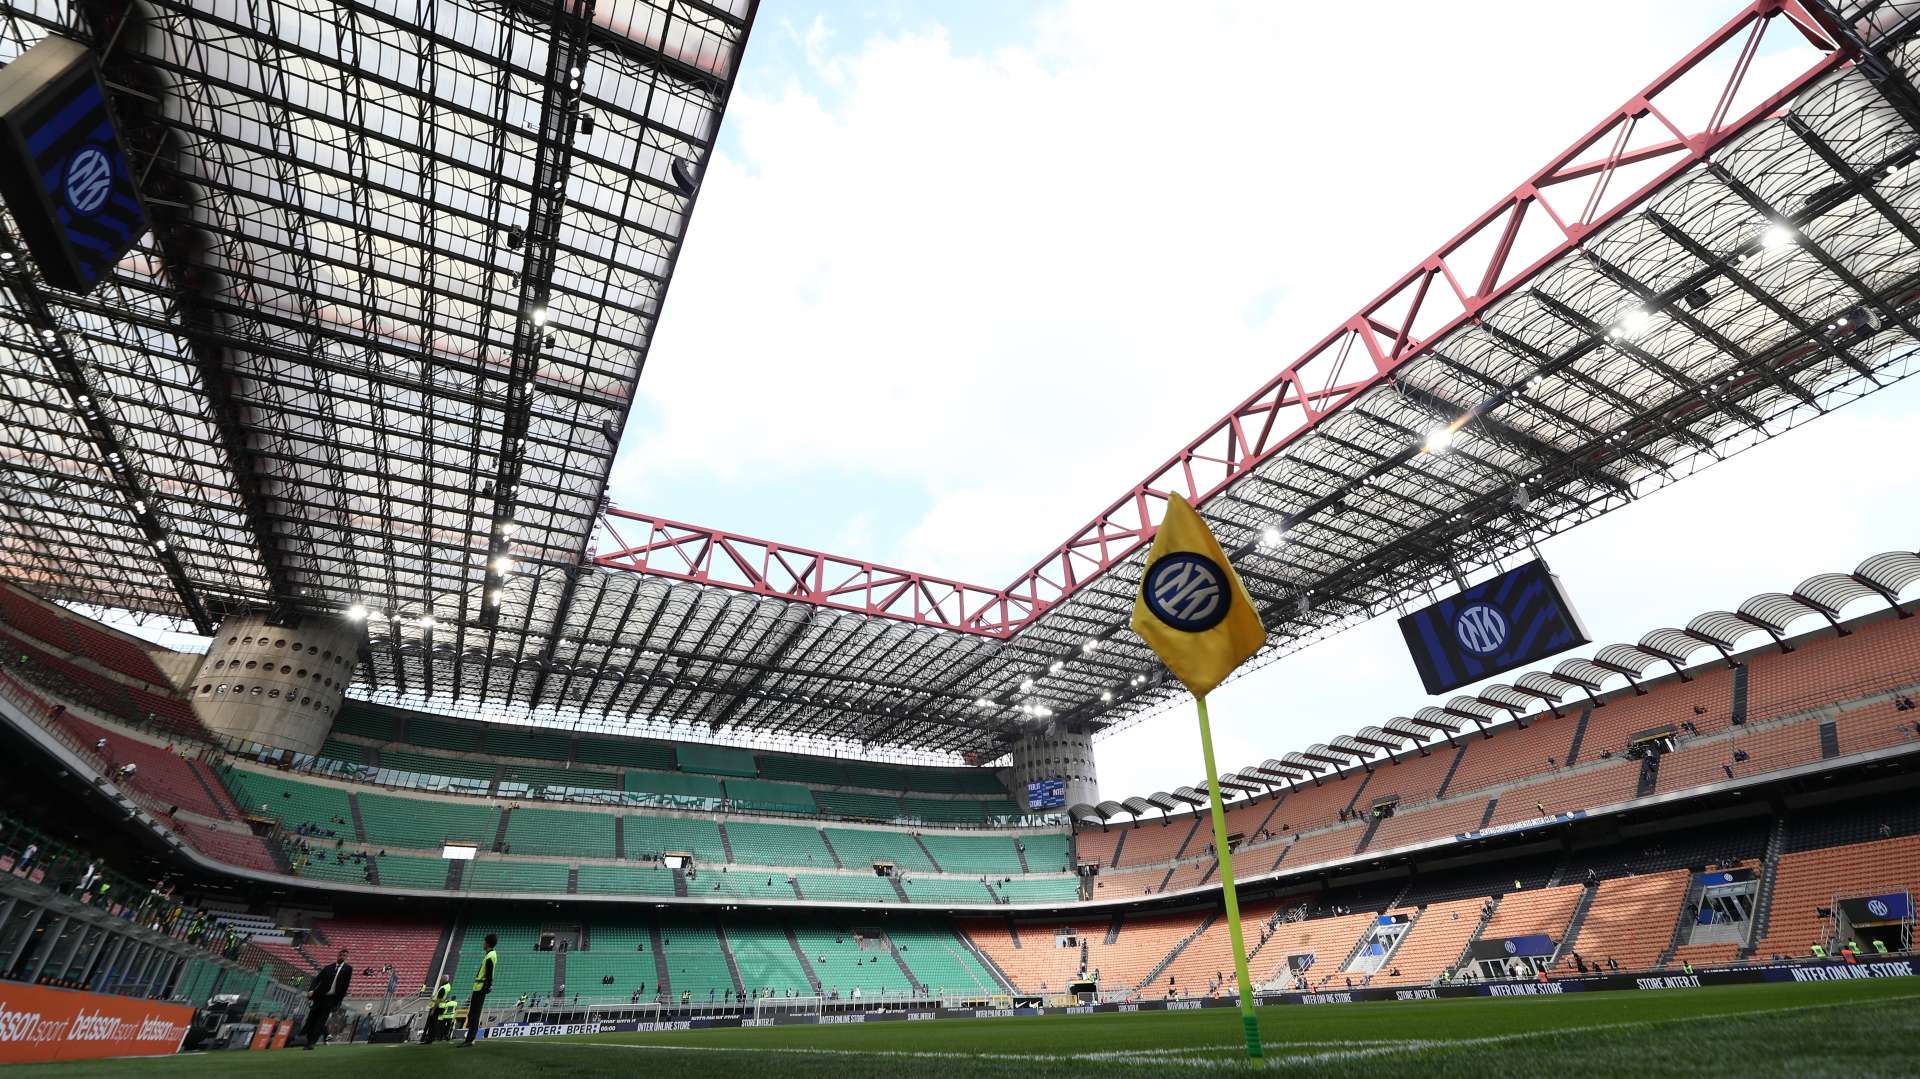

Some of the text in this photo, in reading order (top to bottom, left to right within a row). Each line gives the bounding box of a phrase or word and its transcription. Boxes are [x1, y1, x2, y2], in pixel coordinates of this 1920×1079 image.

[1790, 967, 1828, 982] INTER
[1826, 964, 1870, 980] ONLINE
[1869, 961, 1913, 978] STORE
[1489, 982, 1563, 997] INTER ONLINE STORE
[1637, 976, 1701, 990] STORE.INTER.IT
[672, 1020, 691, 1030] STORE
